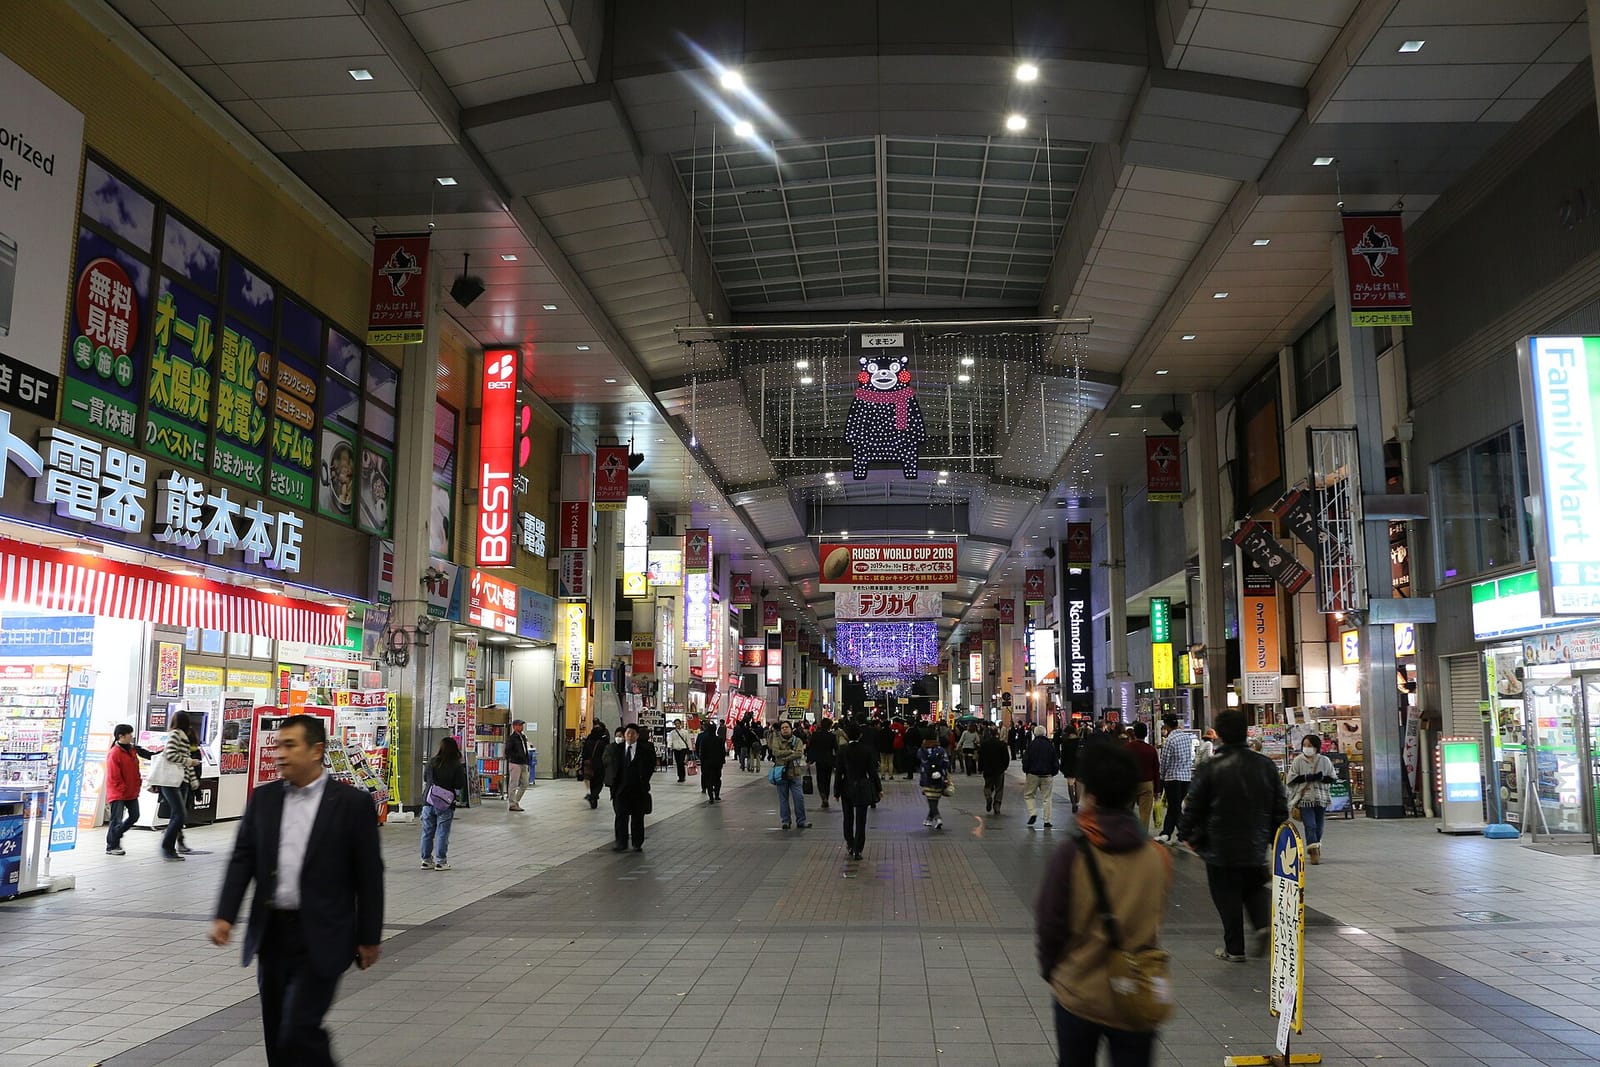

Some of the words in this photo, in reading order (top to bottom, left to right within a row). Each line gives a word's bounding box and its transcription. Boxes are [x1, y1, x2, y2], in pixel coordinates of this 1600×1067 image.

[88, 267, 132, 320] 無料
[86, 304, 129, 354] 見積
[868, 338, 897, 346] くまモン
[77, 340, 130, 382] 実施中
[19, 372, 49, 405] 5F
[487, 381, 513, 390] BEST
[1545, 348, 1590, 545] FamilyMart
[156, 469, 304, 574] 熊本本店
[480, 463, 511, 563] BEST
[852, 548, 880, 560] RUGBY
[883, 548, 912, 560] WORLD
[913, 548, 931, 560] CUP
[932, 548, 954, 560] 2019
[859, 592, 918, 617] テンガイ
[1069, 600, 1084, 660] Richmond
[1072, 662, 1086, 693] Hotel
[338, 693, 349, 705] 祝
[52, 694, 86, 825] WiMAX
[52, 828, 74, 842] 取扱店
